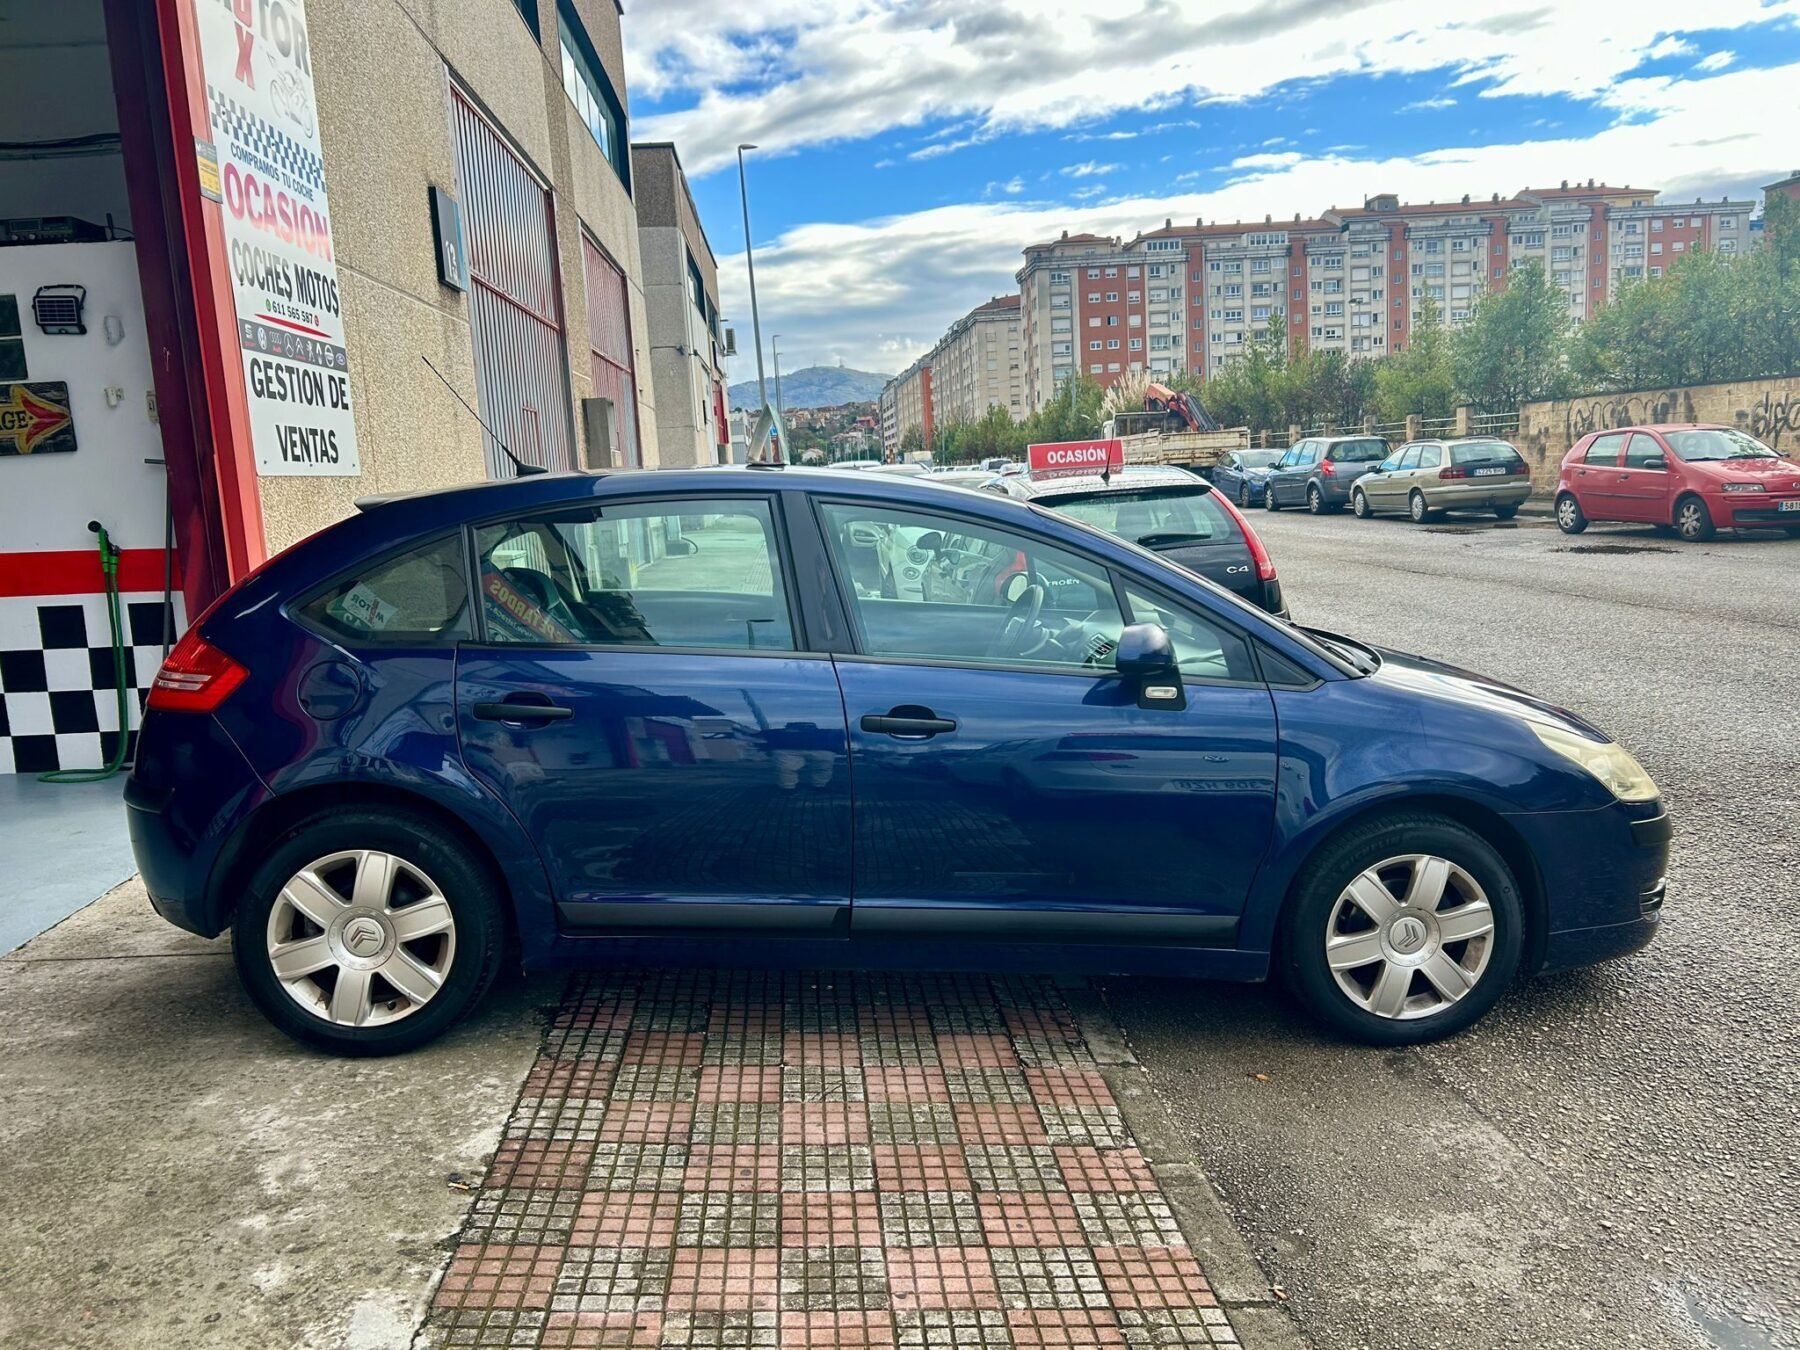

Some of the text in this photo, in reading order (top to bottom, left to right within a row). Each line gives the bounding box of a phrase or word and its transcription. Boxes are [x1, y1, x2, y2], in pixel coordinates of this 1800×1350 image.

[230, 142, 315, 202] COMPRAMOS TU COCHE
[223, 162, 332, 262] OCASION
[231, 238, 340, 316] COCHES MOTOS
[272, 301, 285, 315] 611
[287, 306, 300, 320] 565
[250, 358, 350, 410] GESTION DE
[275, 424, 339, 464] VENTAS
[1047, 445, 1107, 465] OCASIÓN
[1226, 565, 1249, 574] C4
